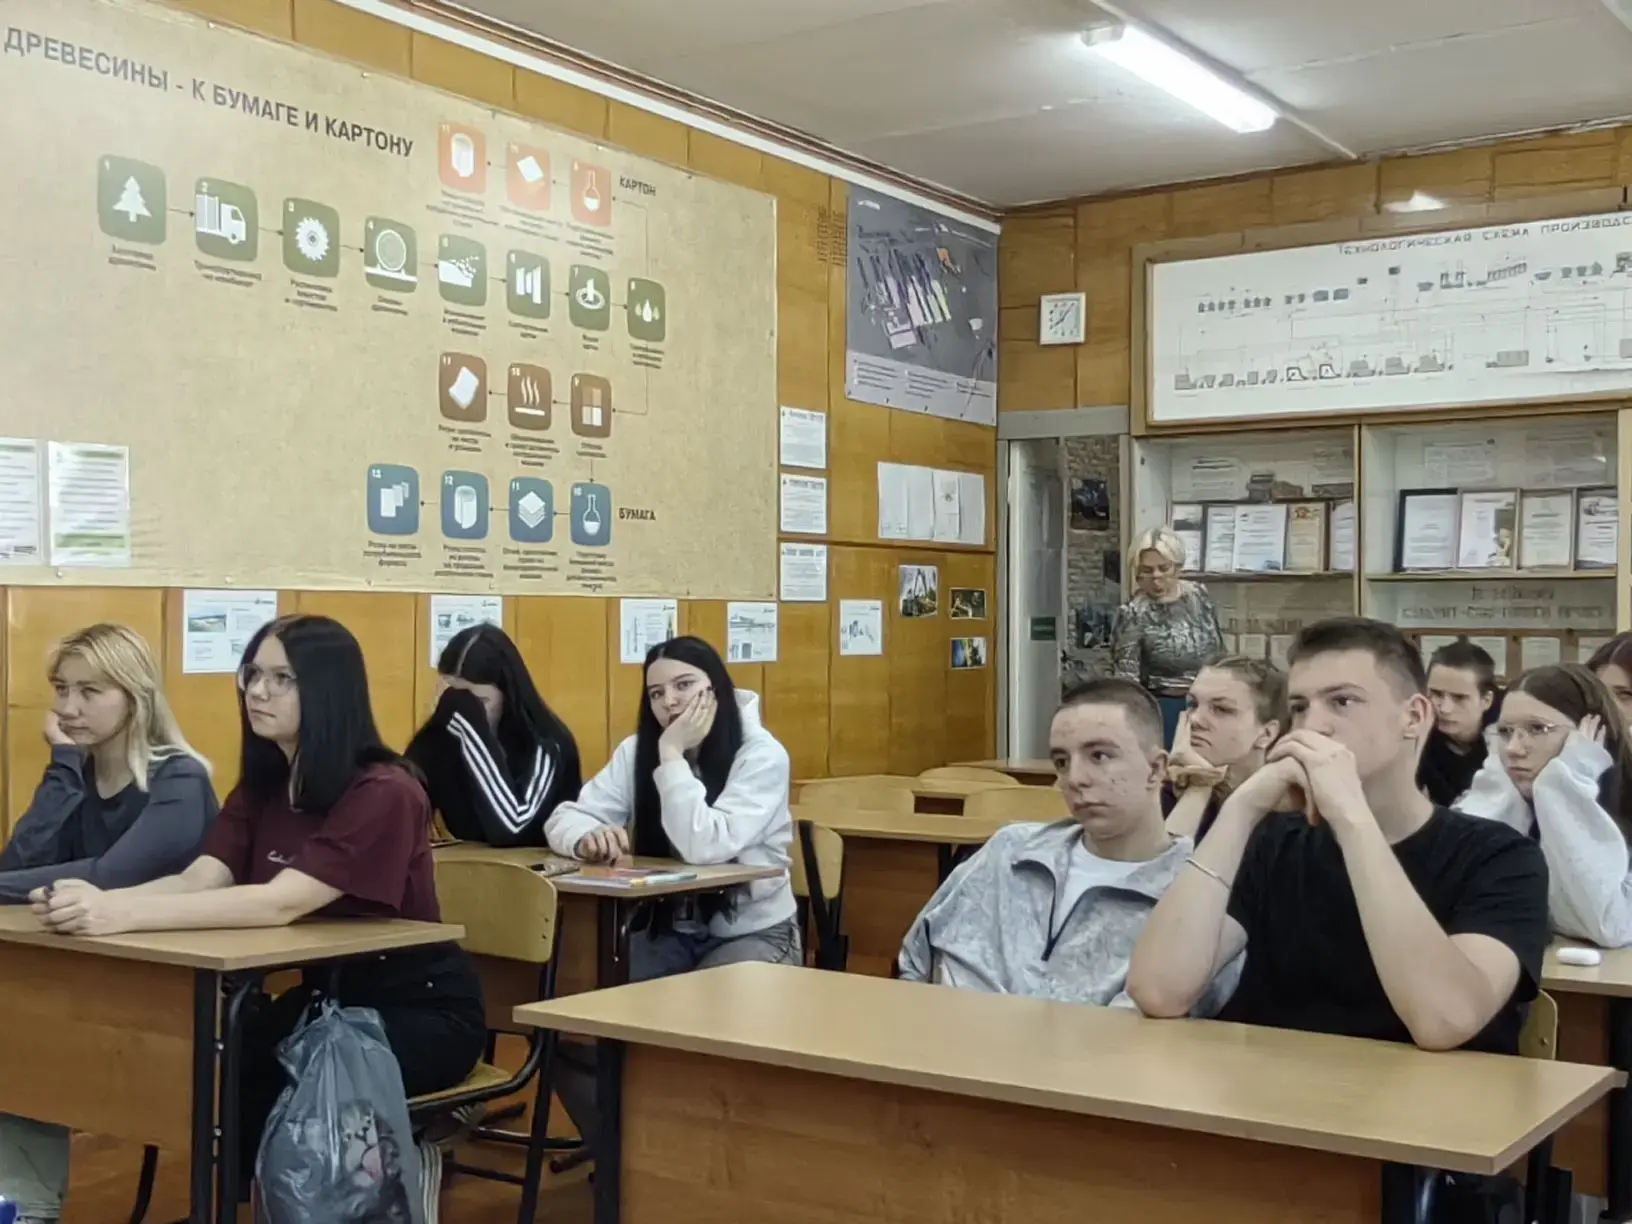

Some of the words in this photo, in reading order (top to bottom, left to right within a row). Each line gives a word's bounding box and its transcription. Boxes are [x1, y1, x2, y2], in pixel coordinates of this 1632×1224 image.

[4, 27, 168, 91] ДРЕВЕСИНЫ
[192, 78, 205, 101] К
[213, 84, 299, 127] БУМАГЕ
[305, 111, 318, 133] И
[325, 116, 413, 157] КАРТОНУ
[619, 175, 656, 196] КАРТОН
[1338, 232, 1472, 255] ТЕХНОЛОГИЧЕСКАЯ
[618, 507, 656, 521] БУМАГА
